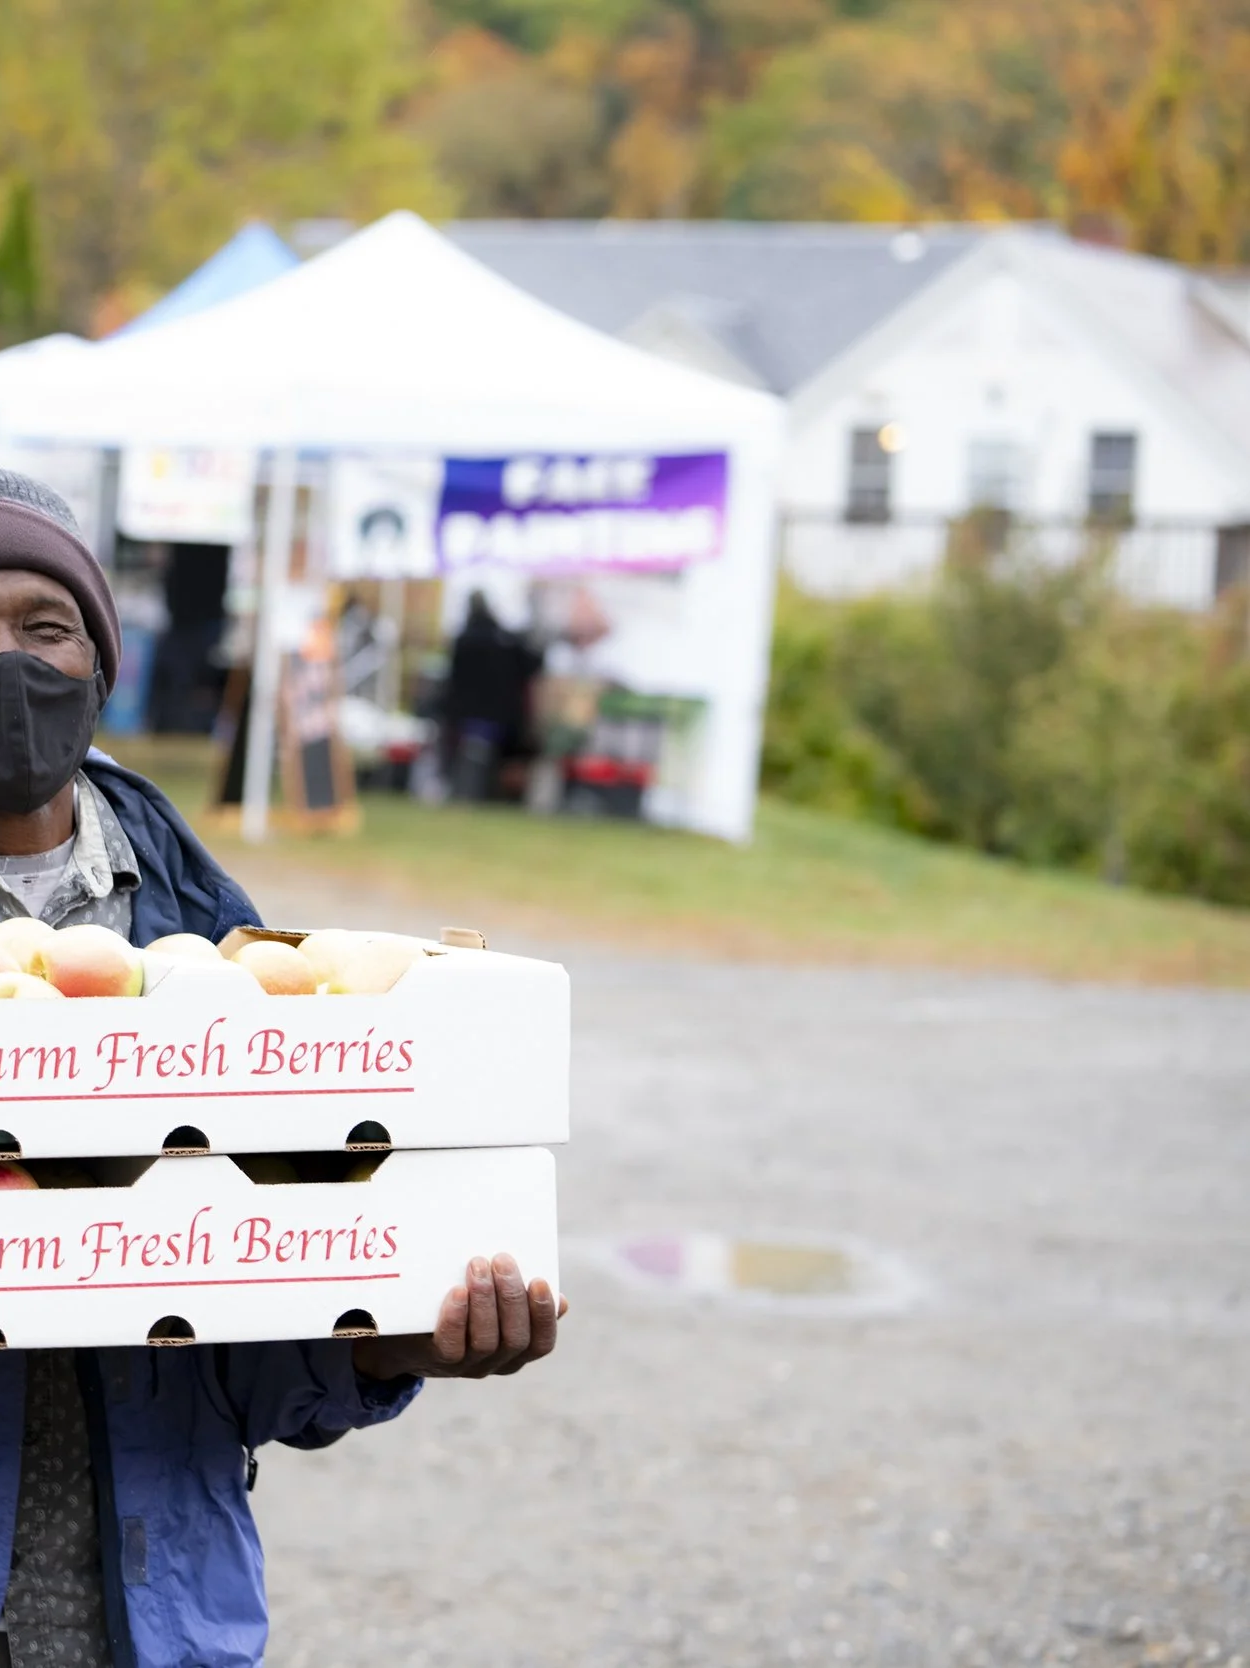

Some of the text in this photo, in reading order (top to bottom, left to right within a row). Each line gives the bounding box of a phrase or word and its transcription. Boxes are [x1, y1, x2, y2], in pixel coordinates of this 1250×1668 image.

[92, 1017, 230, 1092] Fresh
[247, 1026, 415, 1076] Berries
[77, 1206, 215, 1282] Fresh
[233, 1214, 399, 1264] Berries
